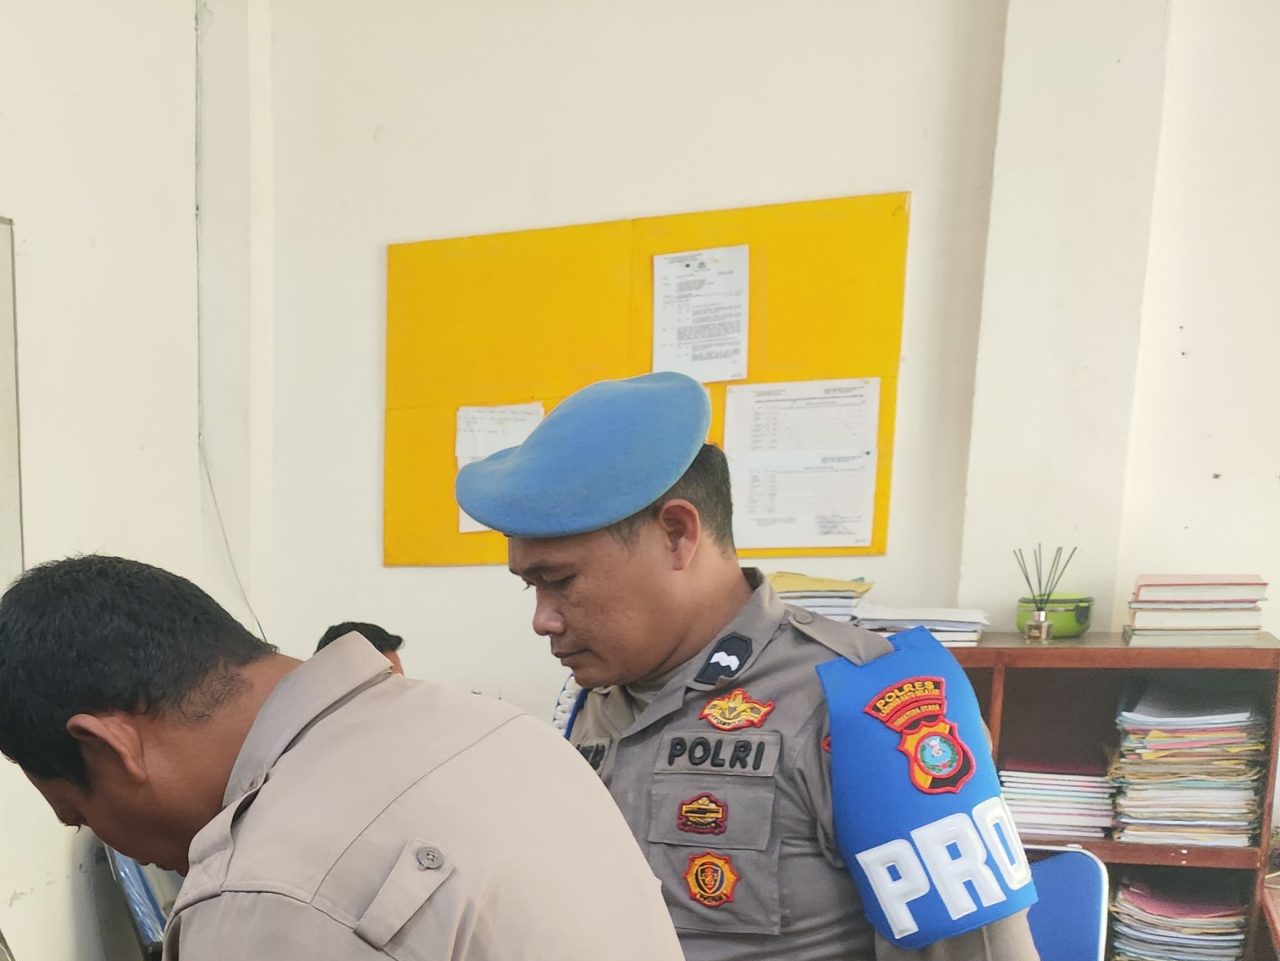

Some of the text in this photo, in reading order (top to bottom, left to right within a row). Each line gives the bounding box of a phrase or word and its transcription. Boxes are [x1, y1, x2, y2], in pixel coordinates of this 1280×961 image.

[876, 681, 935, 709] POLRES
[667, 736, 766, 771] POLRI
[855, 795, 1033, 940] PRO
